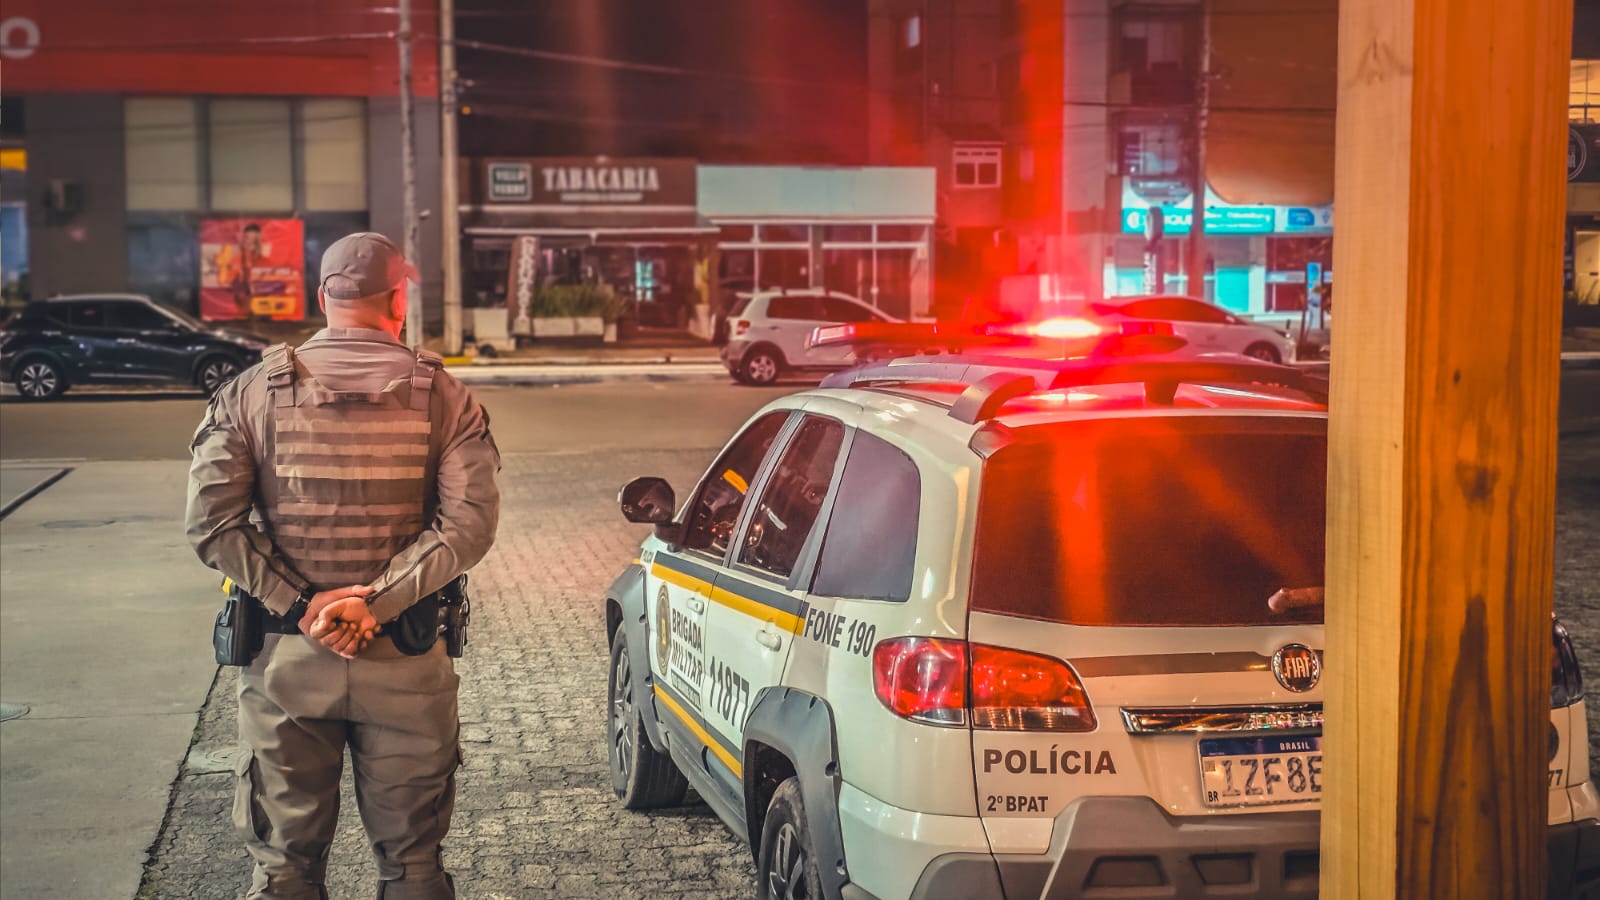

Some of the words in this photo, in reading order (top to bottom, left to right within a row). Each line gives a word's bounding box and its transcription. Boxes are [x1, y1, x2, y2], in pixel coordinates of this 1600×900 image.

[542, 167, 660, 192] TABACARIA
[671, 607, 703, 653] BRIGADA
[804, 607, 846, 650] FONE
[846, 618, 876, 658] 190
[671, 639, 703, 688] MILITAR
[1284, 656, 1310, 679] FIAT
[709, 655, 750, 733] 11877
[983, 743, 1117, 775] POLÍCIA
[1279, 741, 1311, 751] BRASIL
[1005, 795, 1049, 812] BPAT
[1207, 791, 1219, 803] BR
